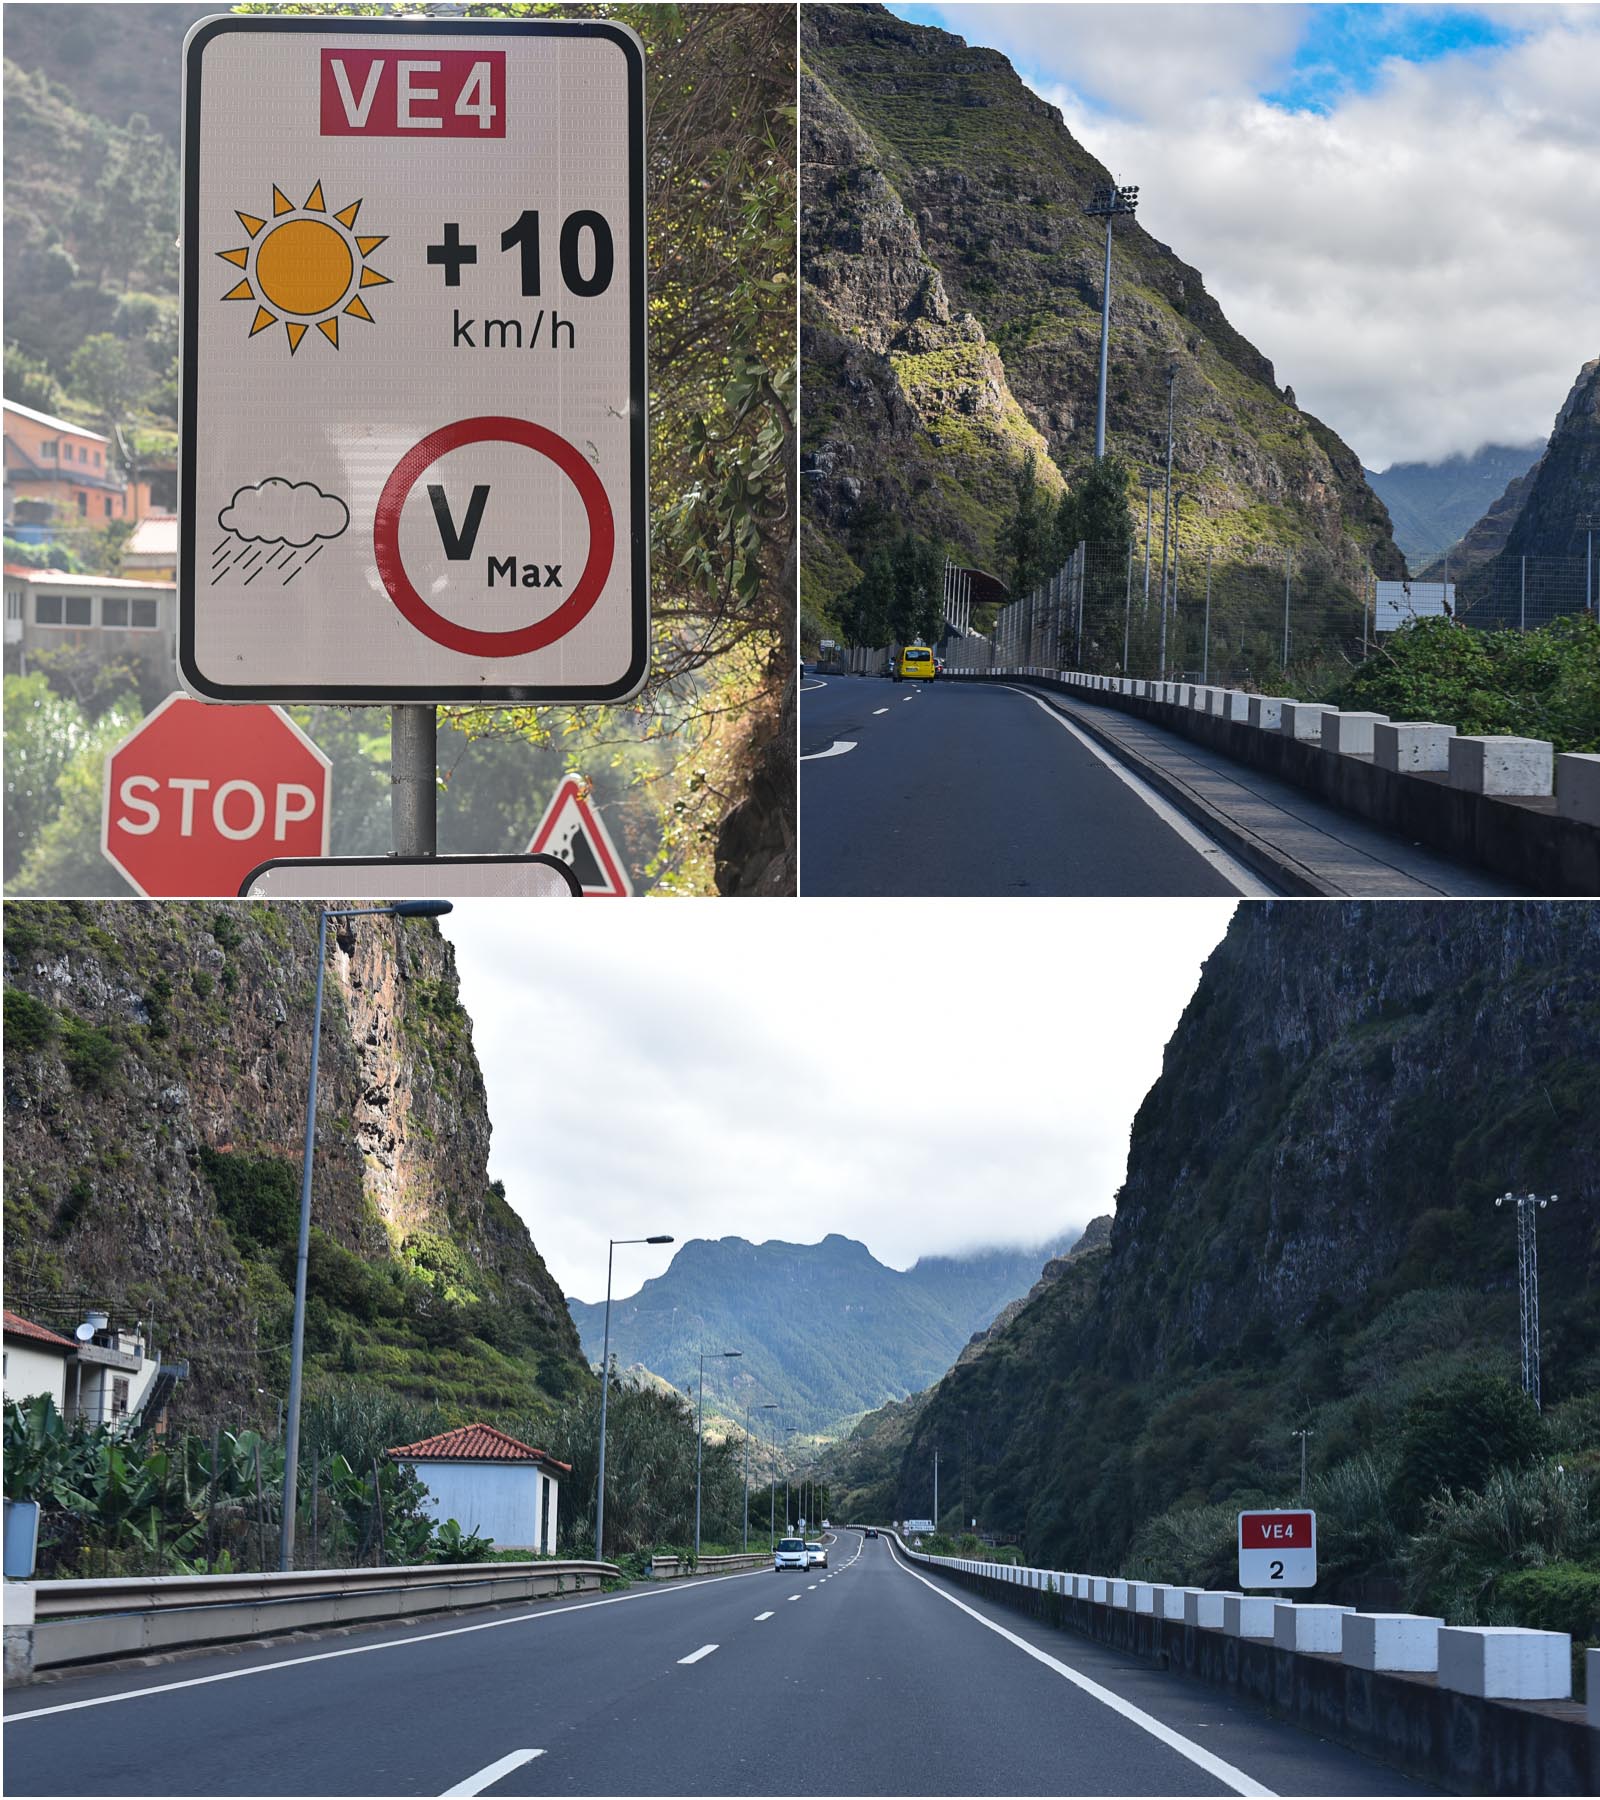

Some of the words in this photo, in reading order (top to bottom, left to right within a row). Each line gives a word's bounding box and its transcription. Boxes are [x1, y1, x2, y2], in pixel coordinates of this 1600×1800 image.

[330, 59, 497, 129] VE4
[426, 209, 615, 297] +10
[453, 309, 575, 349] km/h
[427, 484, 491, 561] V
[487, 556, 563, 588] Max
[116, 775, 316, 841] STOP
[1261, 1524, 1294, 1539] VE4
[1269, 1560, 1284, 1580] 2
